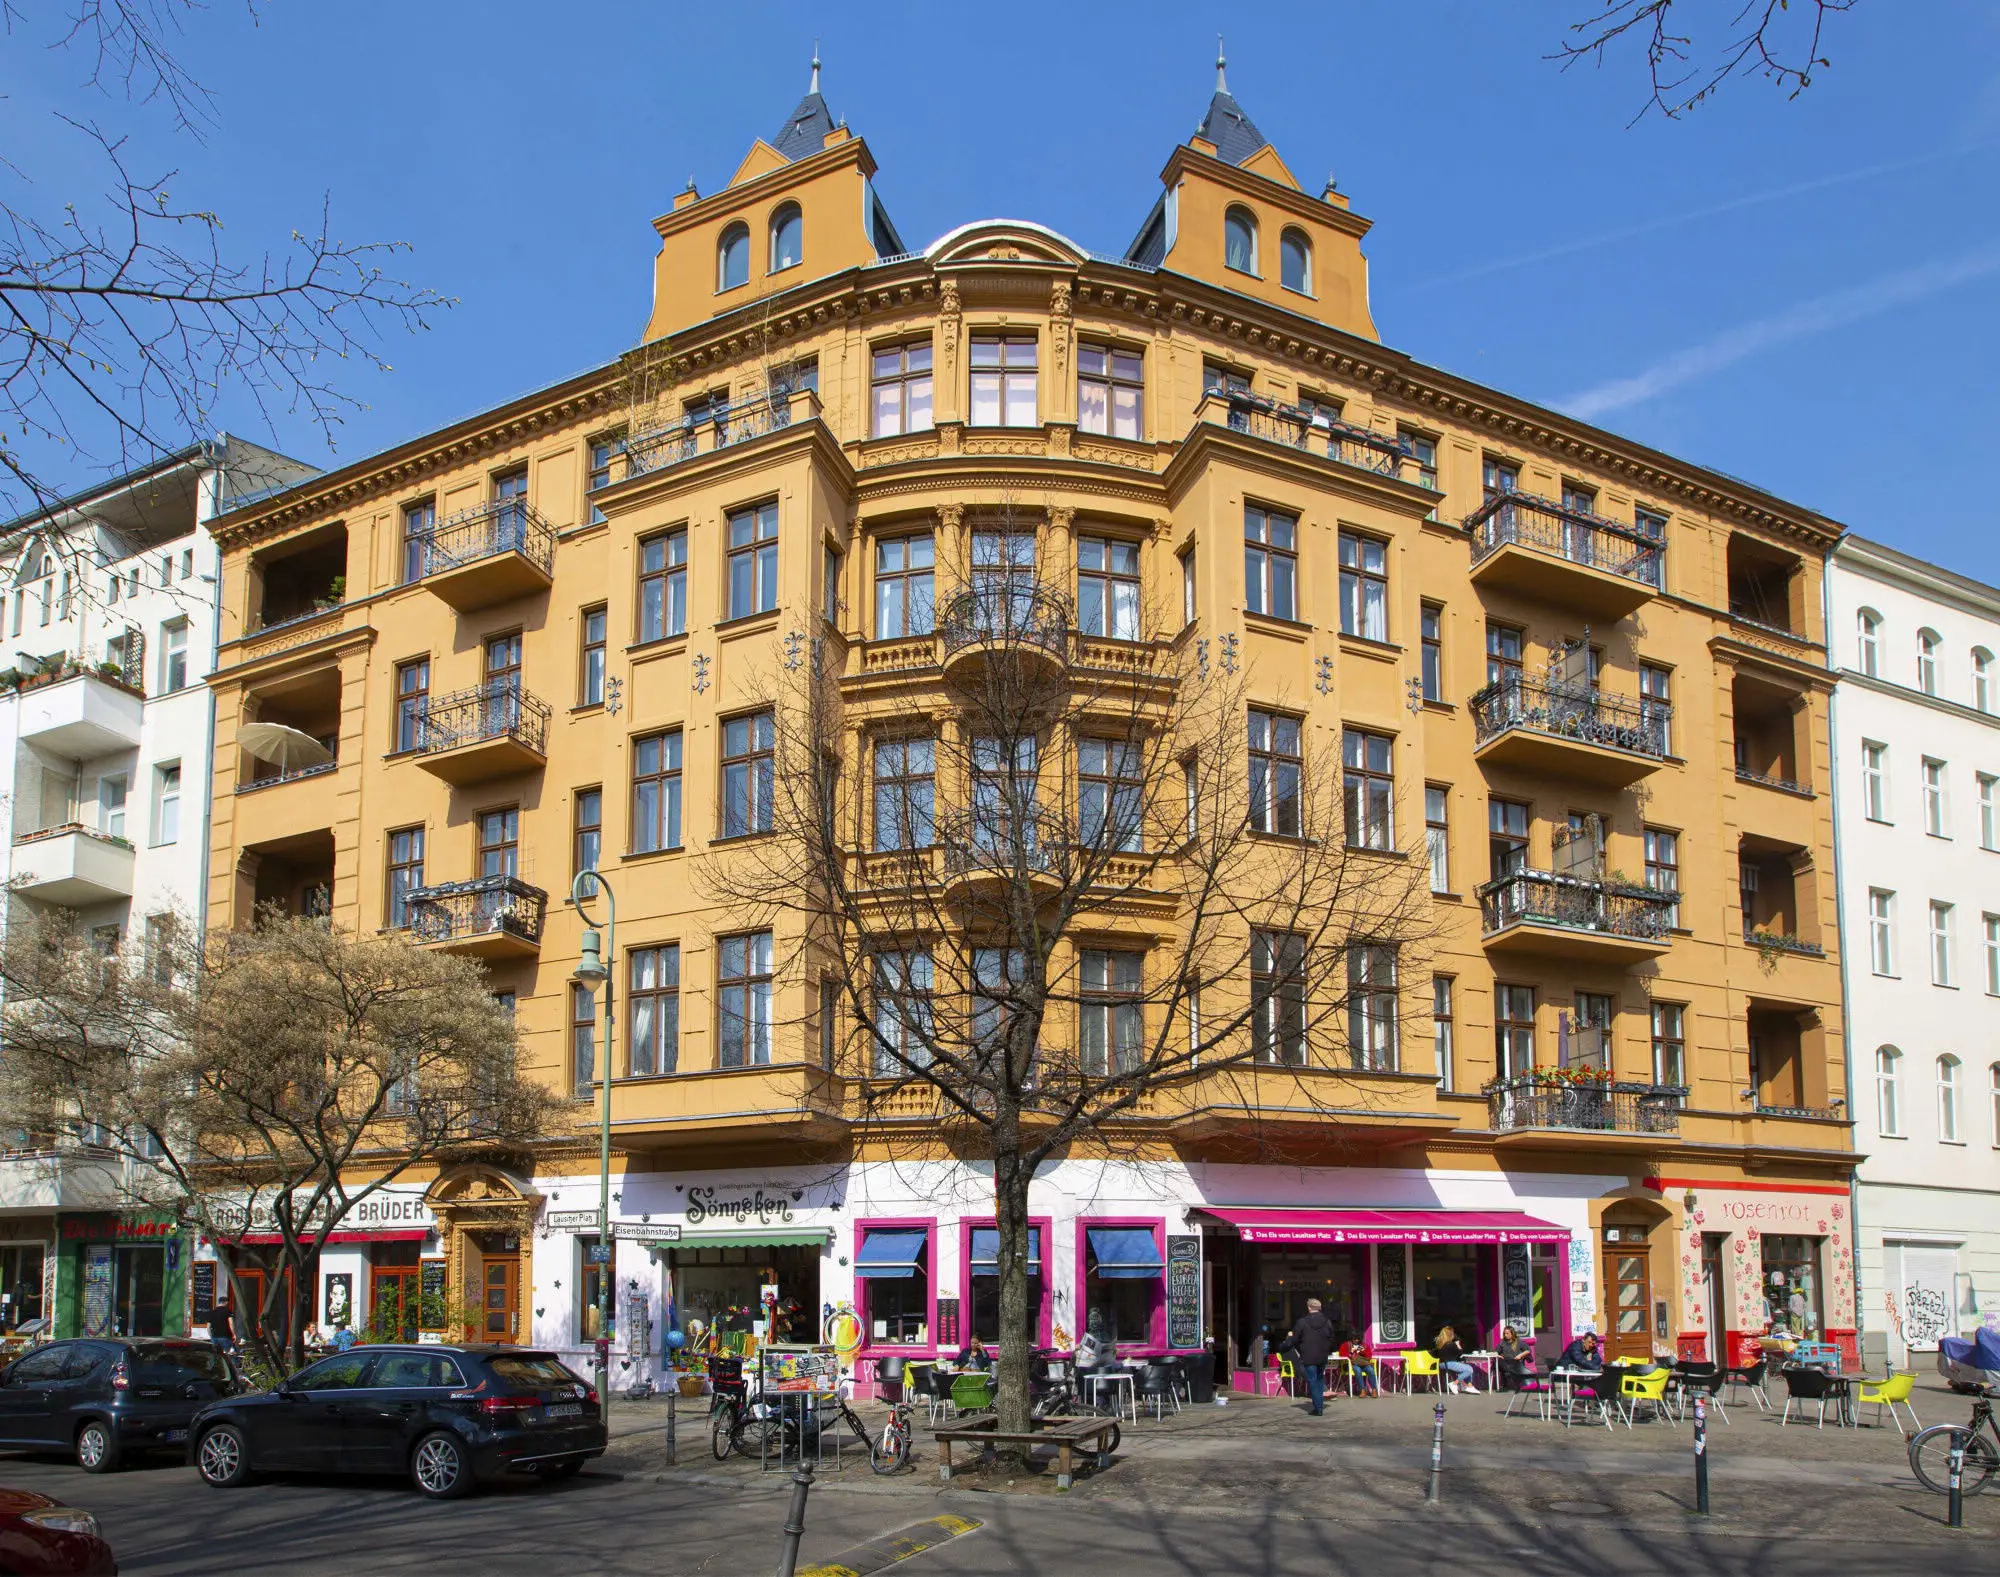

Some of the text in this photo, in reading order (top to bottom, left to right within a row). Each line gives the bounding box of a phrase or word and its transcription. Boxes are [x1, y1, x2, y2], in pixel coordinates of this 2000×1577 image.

[358, 1197, 424, 1221] BRÜDER
[686, 1187, 793, 1224] Sönneken
[1722, 1202, 1809, 1221] rosenrot
[553, 1213, 593, 1223] Lausitzer Platz
[615, 1226, 678, 1237] Eisenbahnstraße
